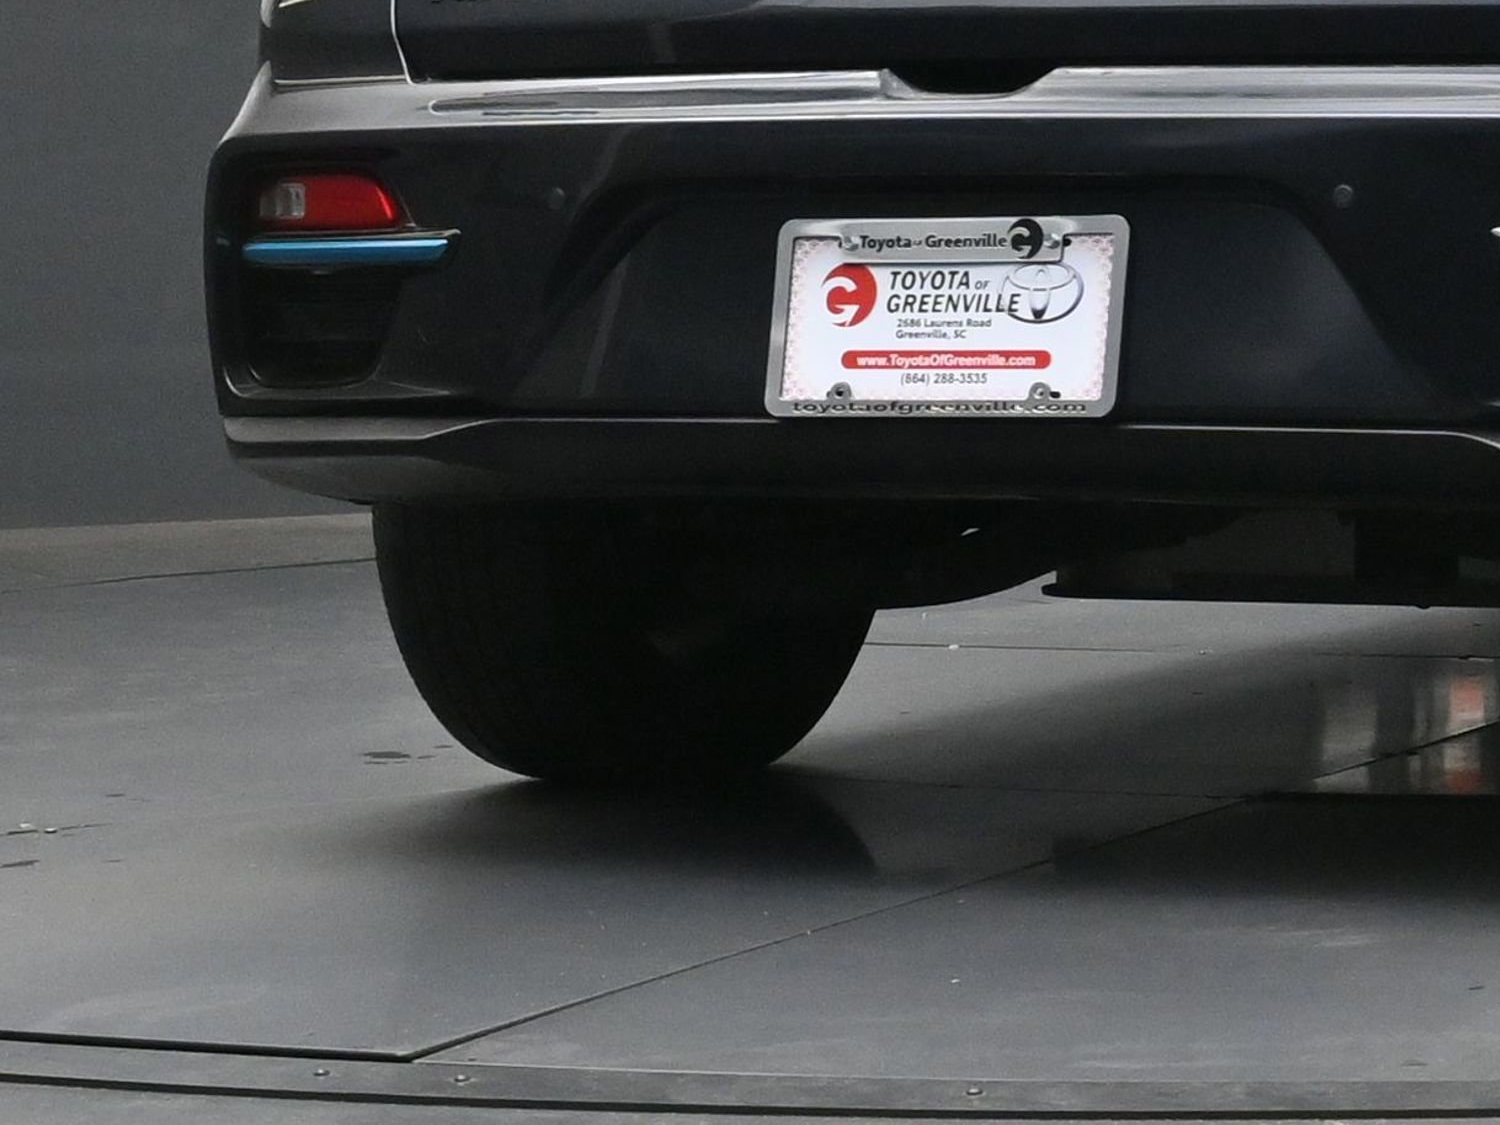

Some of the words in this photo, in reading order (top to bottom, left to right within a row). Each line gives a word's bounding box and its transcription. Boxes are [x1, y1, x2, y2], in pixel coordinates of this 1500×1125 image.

[860, 235, 912, 252] Toyota
[925, 233, 1007, 248] Greenville
[890, 270, 970, 290] TOYOTA
[974, 280, 990, 290] OF
[887, 293, 1021, 313] GREENVILLE
[924, 318, 963, 328] Laurens
[966, 318, 992, 328] Road
[896, 329, 951, 340] Greenville,
[953, 329, 967, 339] SC
[856, 354, 1036, 368] www.ToyotaOfGreenville.com
[900, 372, 930, 386] (864)
[933, 372, 988, 385] 288-3535
[793, 401, 1087, 415] toyotaofgreenville.com
